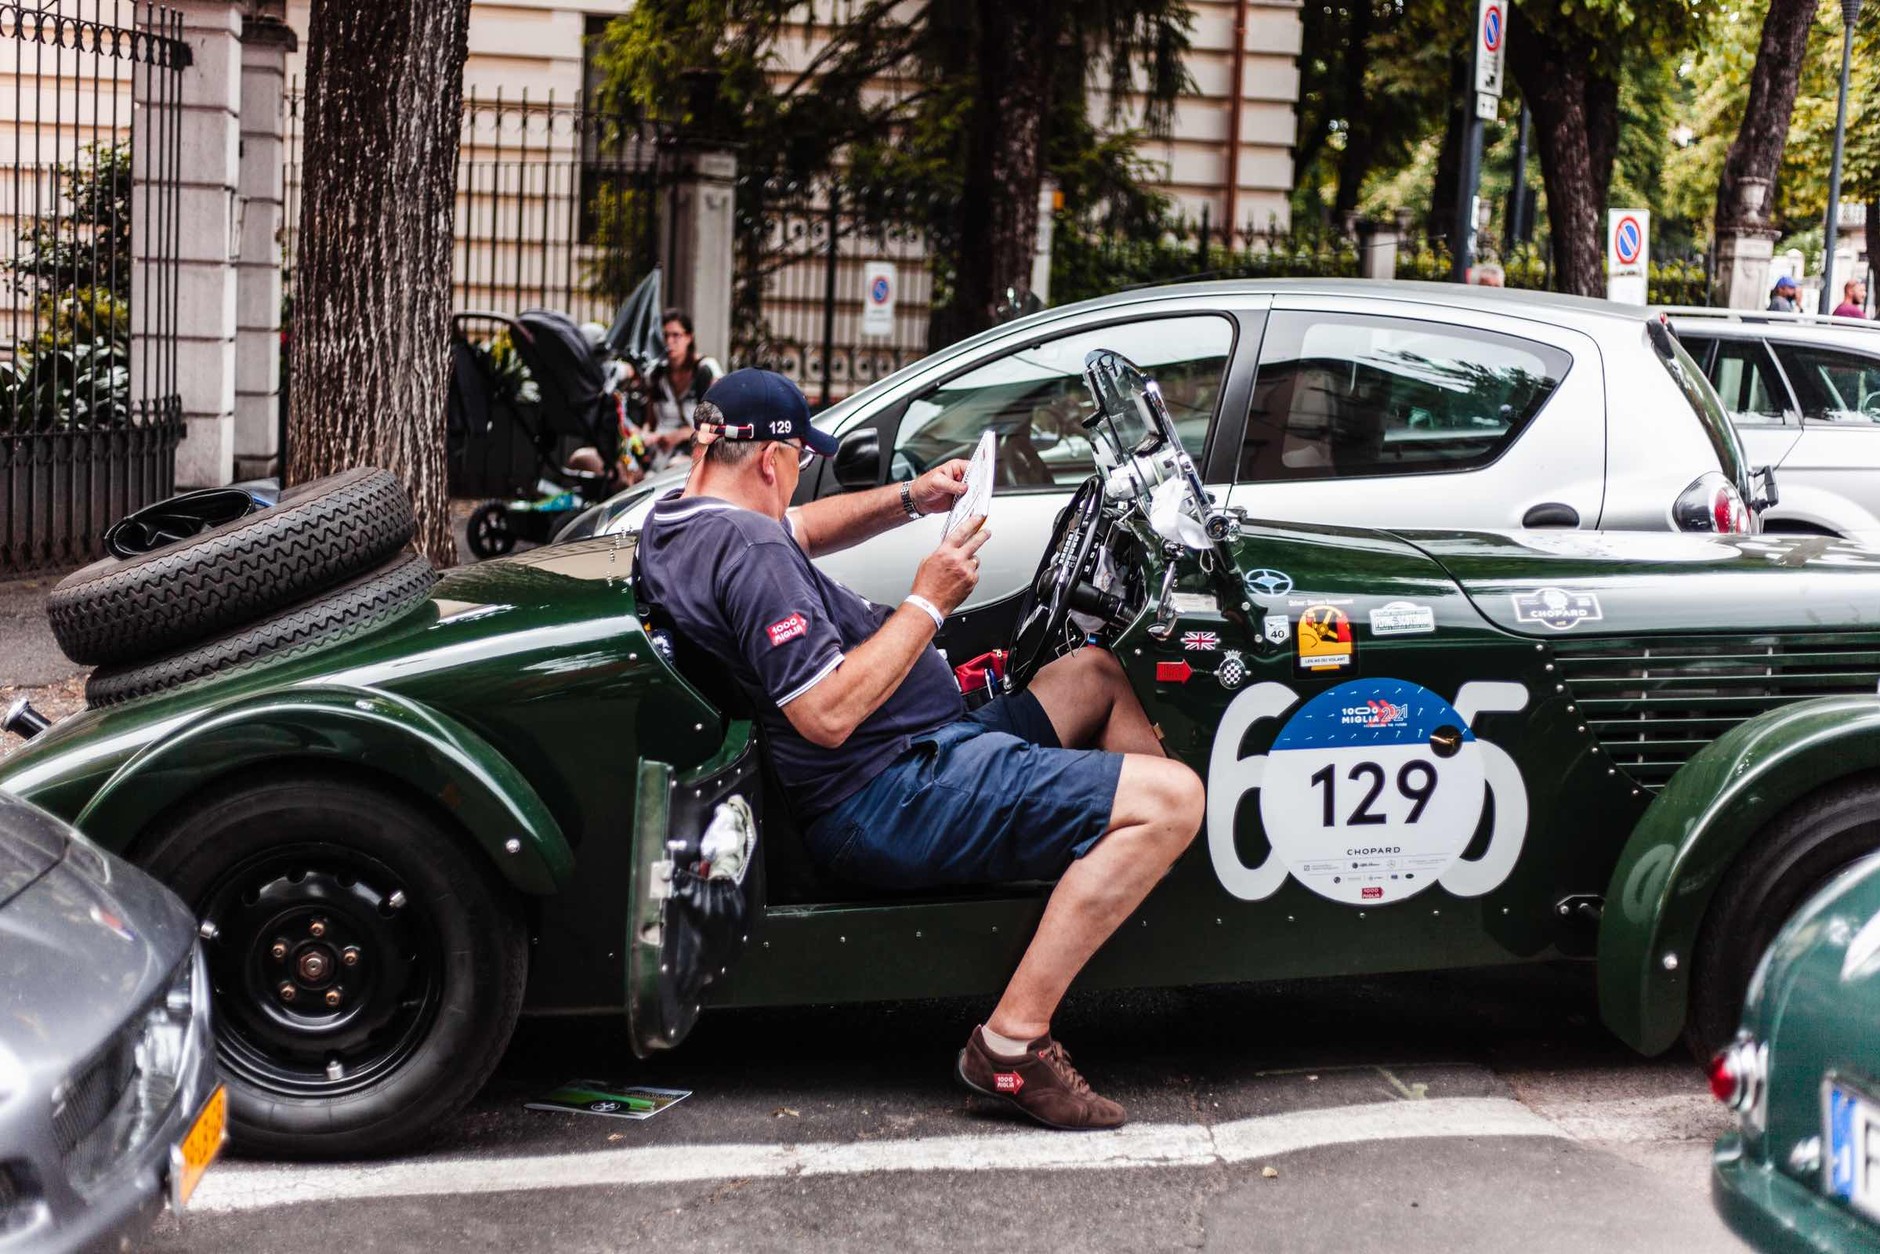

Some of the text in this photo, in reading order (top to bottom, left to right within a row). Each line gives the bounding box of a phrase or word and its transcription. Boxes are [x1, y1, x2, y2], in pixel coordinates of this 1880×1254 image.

[769, 420, 792, 435] 129
[1529, 609, 1588, 618] CHOPARD
[772, 617, 798, 635] 1000
[1271, 630, 1285, 639] 40
[1341, 703, 1408, 723] 1000 2021
[1341, 715, 1379, 724] MIGLIA
[1311, 759, 1439, 828] 129
[1347, 847, 1401, 856] CHOPARD
